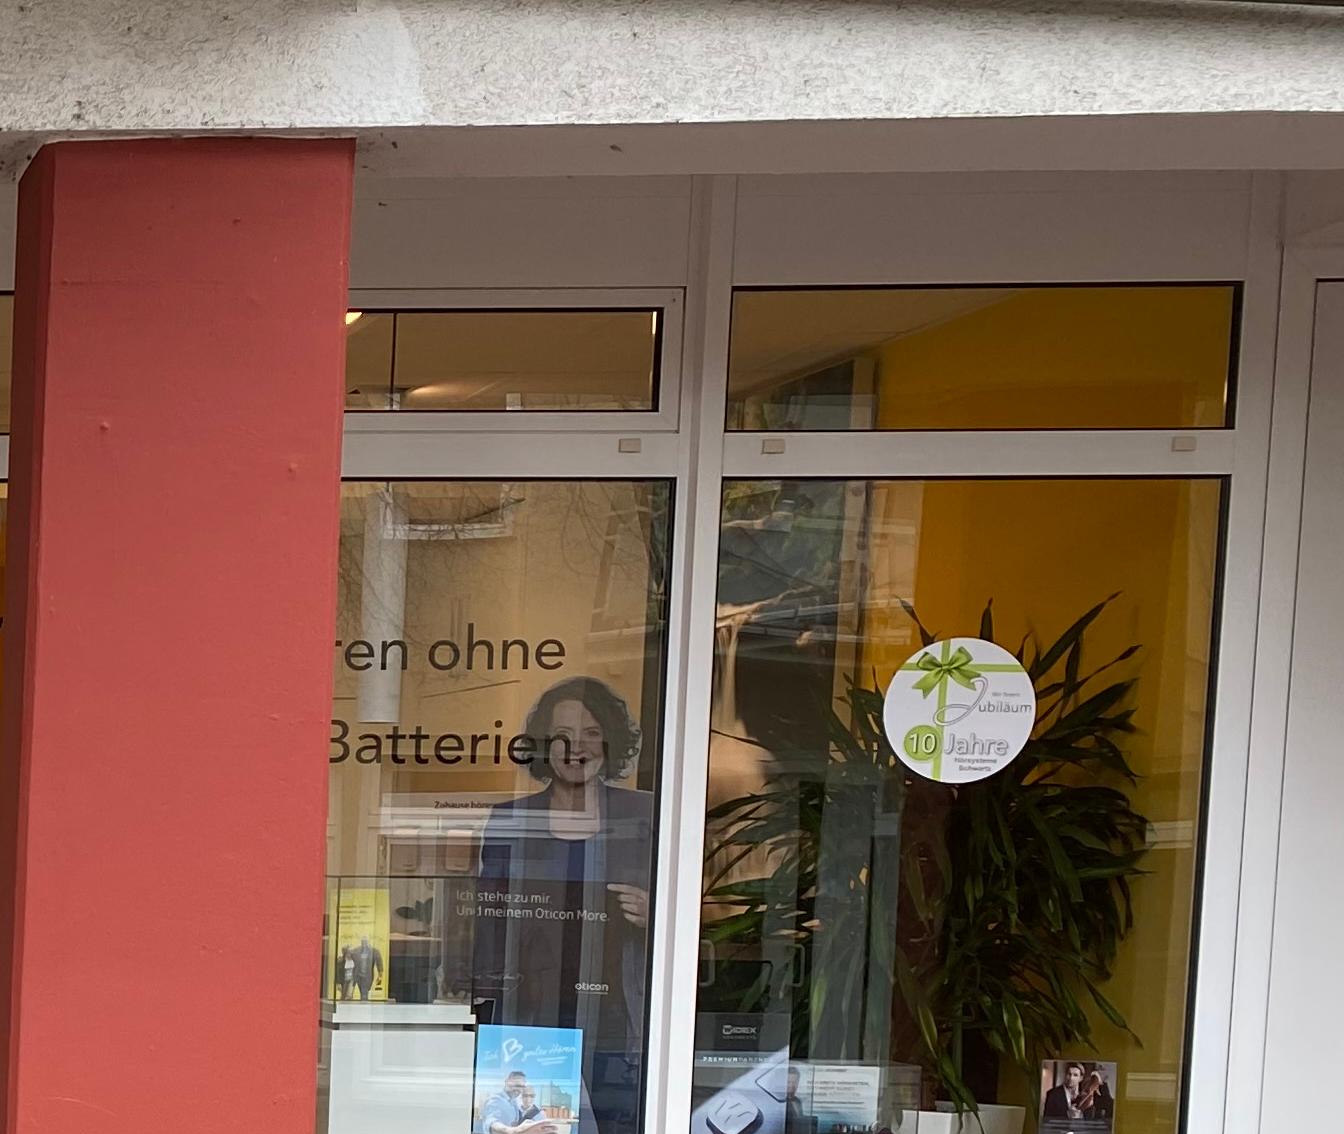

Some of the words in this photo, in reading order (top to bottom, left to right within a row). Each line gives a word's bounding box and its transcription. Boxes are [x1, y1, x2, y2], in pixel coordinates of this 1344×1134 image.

[428, 622, 566, 671] ohne
[328, 719, 587, 765] Batterien.
[908, 732, 937, 755] 10
[943, 732, 1009, 757] Jahre
[456, 890, 473, 901] Ich
[478, 891, 512, 903] stehe
[514, 894, 528, 903] zu
[456, 905, 482, 917] Und
[484, 906, 533, 919] meinem
[535, 907, 575, 921] Oticon
[574, 982, 609, 992] oticon
[722, 1024, 758, 1035] WIDEX
